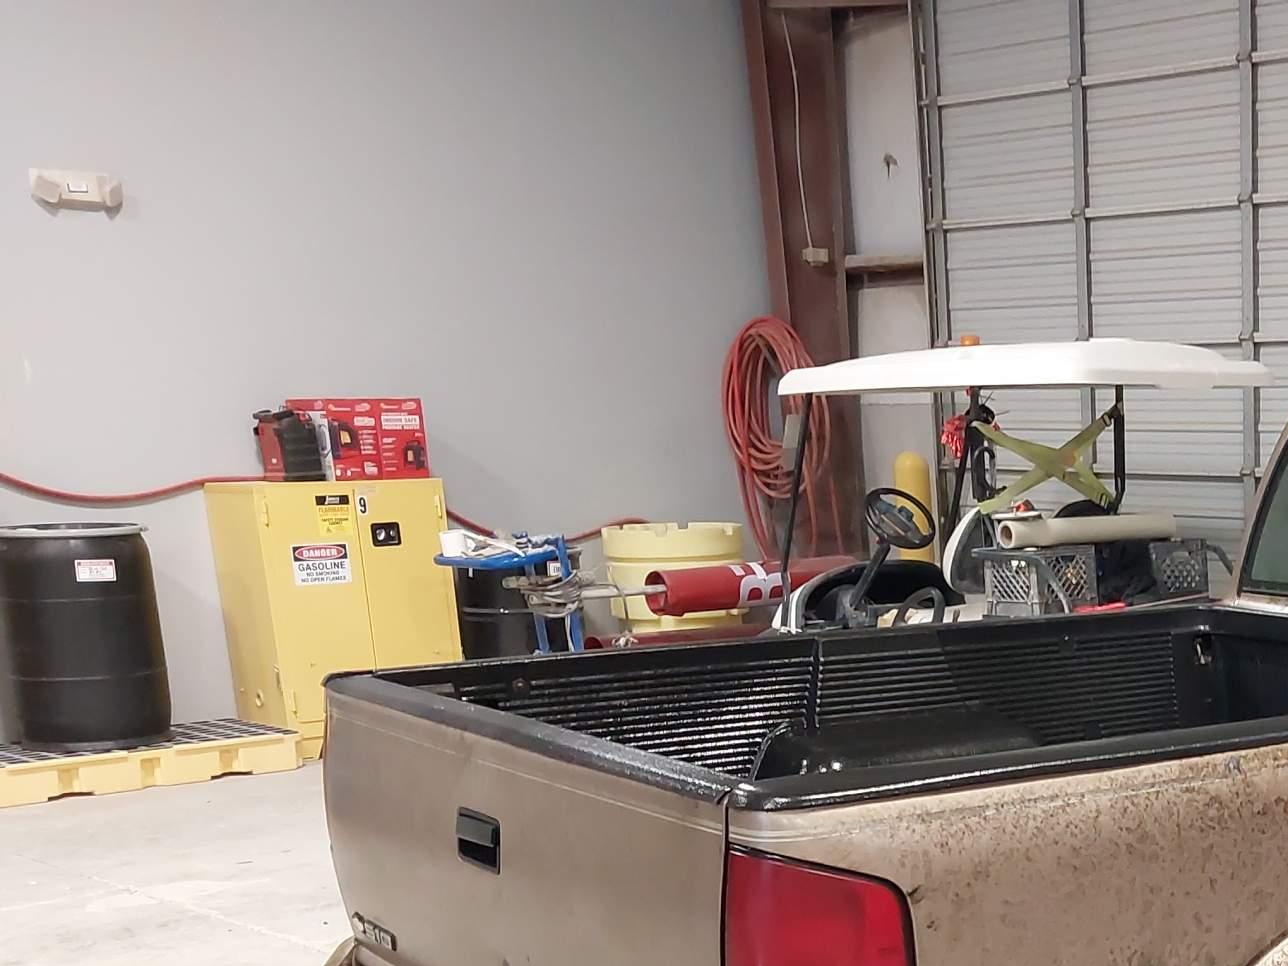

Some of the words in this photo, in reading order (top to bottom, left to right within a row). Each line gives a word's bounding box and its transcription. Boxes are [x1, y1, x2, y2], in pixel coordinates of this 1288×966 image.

[359, 497, 367, 514] 9
[302, 548, 337, 558] DANGER
[298, 561, 346, 572] GASOLINE
